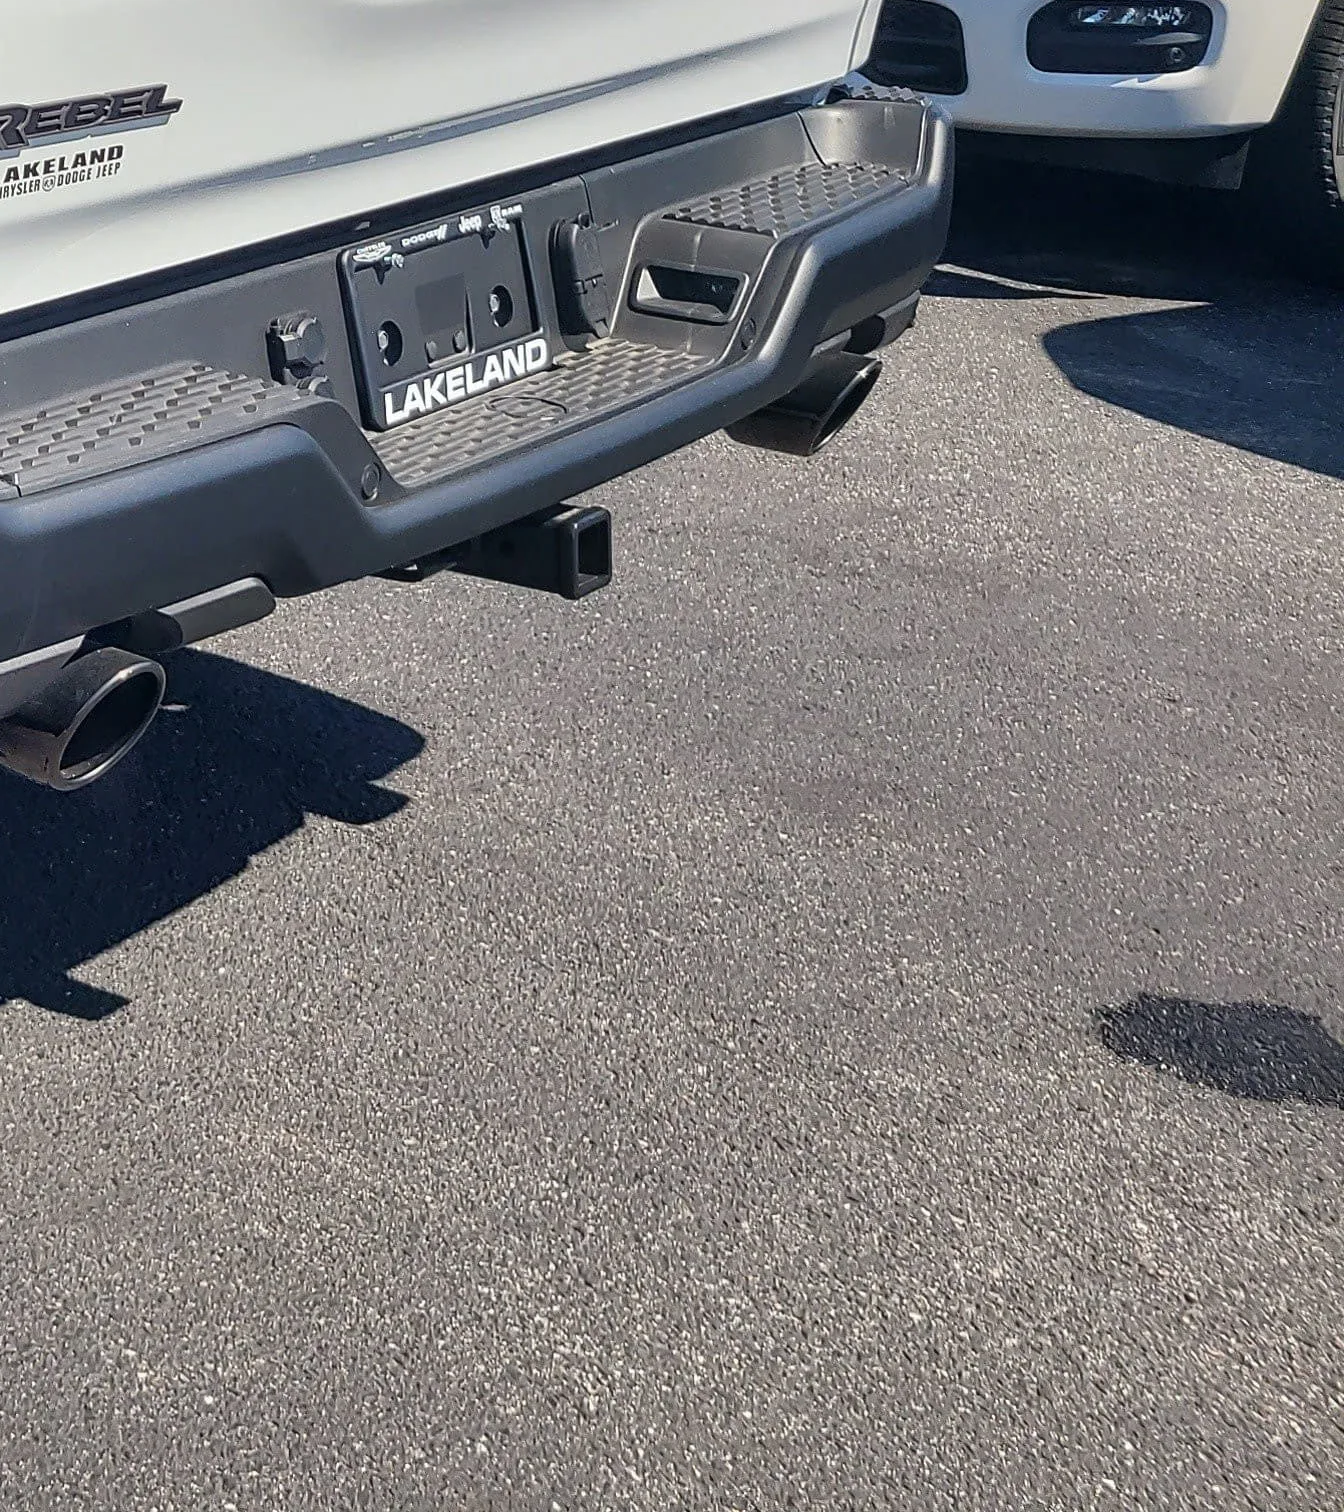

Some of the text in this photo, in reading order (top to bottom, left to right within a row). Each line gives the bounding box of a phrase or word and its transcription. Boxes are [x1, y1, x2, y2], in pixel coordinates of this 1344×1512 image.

[57, 168, 92, 187] DODGE
[96, 162, 121, 178] JEEP
[459, 214, 482, 233] Jeep
[501, 204, 523, 217] RAM
[384, 338, 548, 426] LAKELAND
